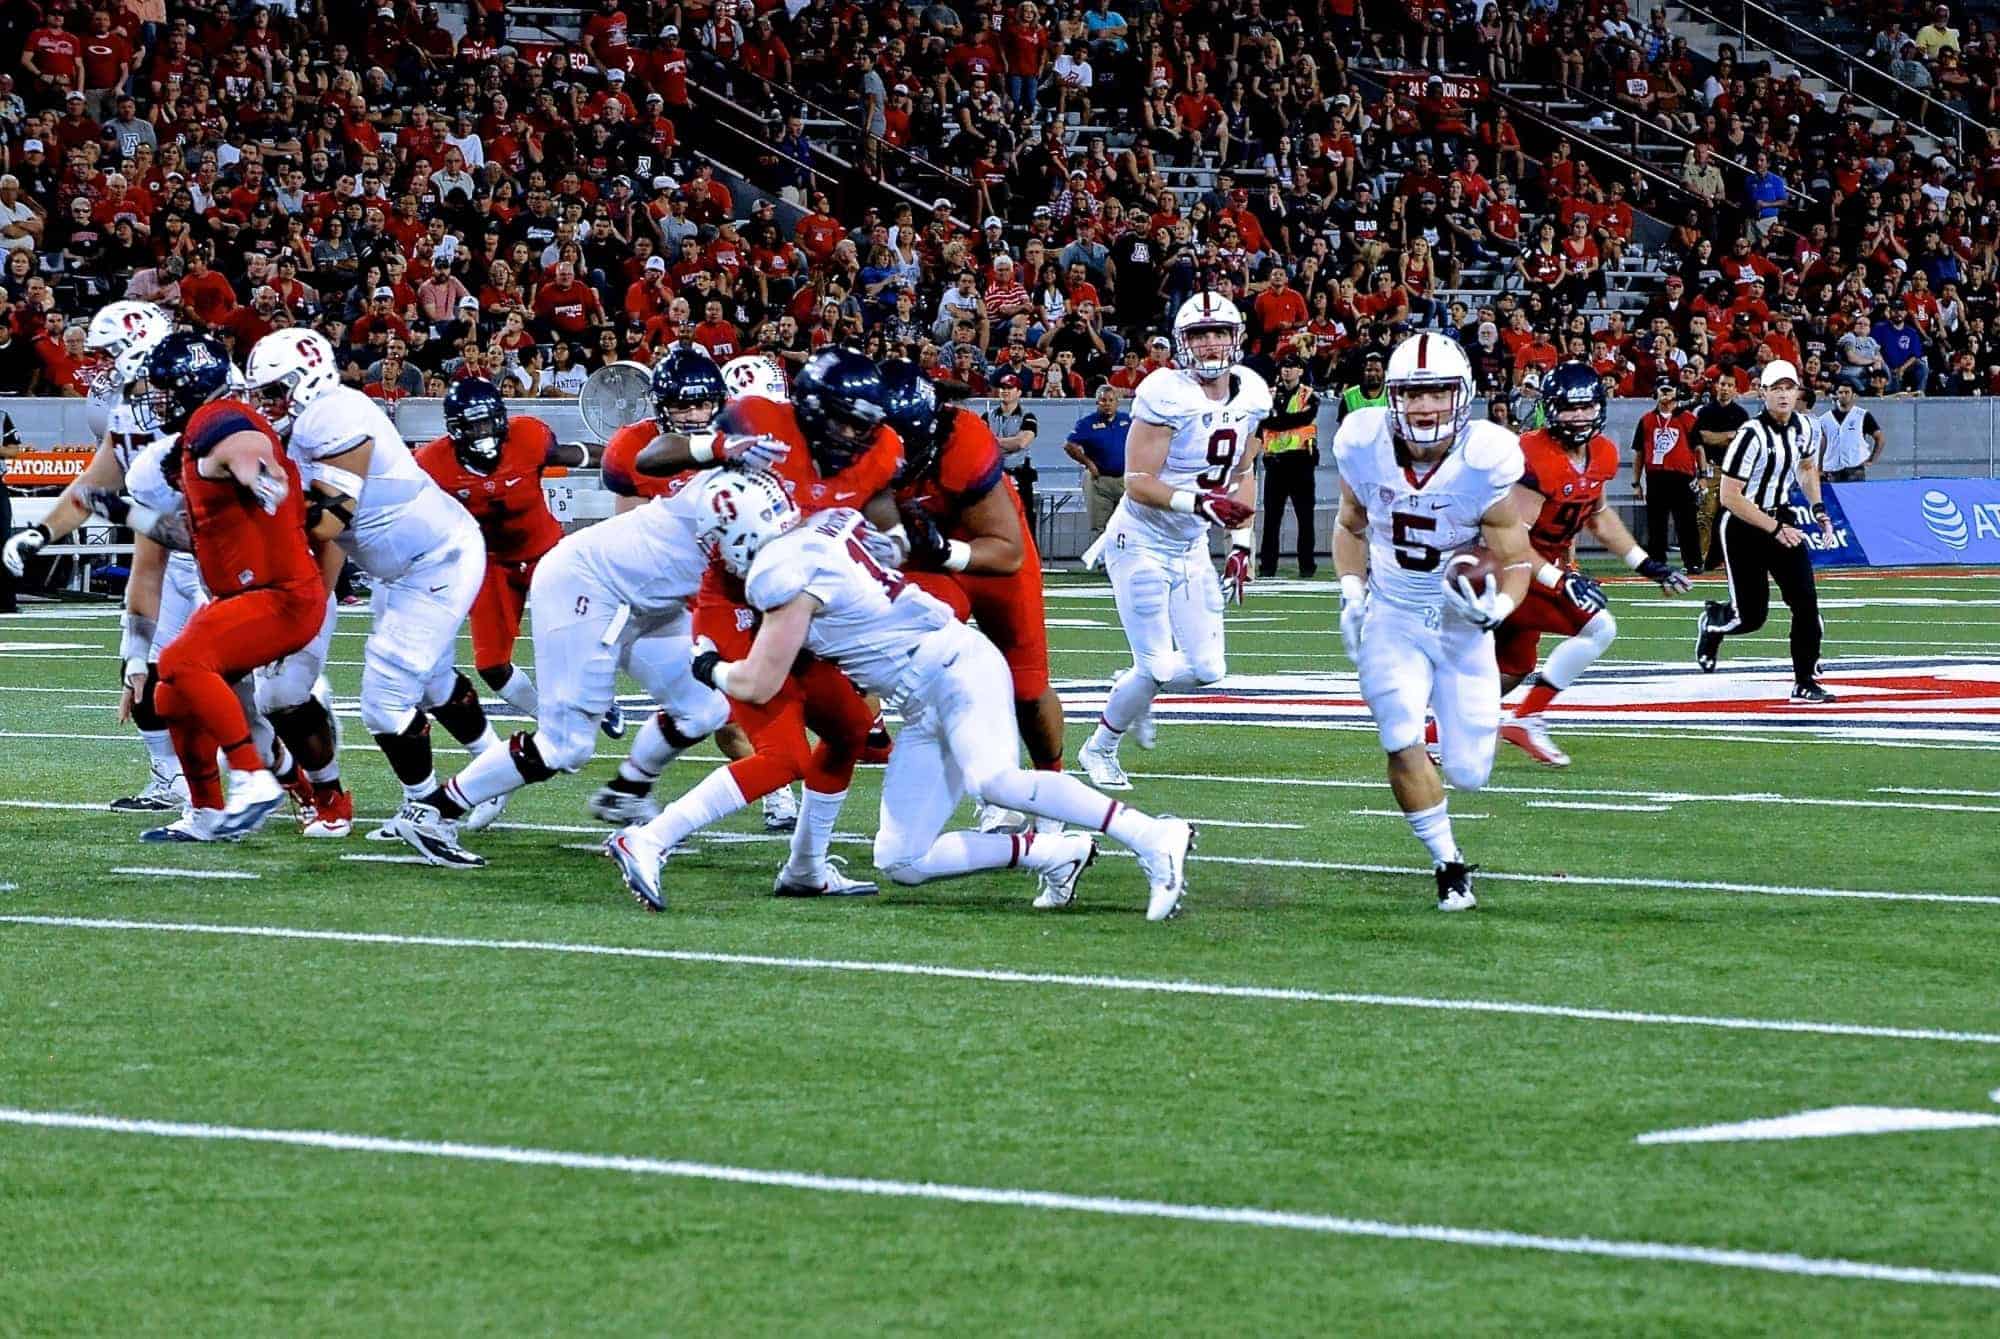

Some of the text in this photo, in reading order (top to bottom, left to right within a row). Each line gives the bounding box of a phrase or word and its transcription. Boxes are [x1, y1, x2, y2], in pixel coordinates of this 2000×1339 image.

[187, 343, 219, 371] A
[296, 338, 322, 368] S
[1197, 428, 1238, 490] 9
[711, 489, 738, 526] S
[1391, 511, 1441, 573] 5
